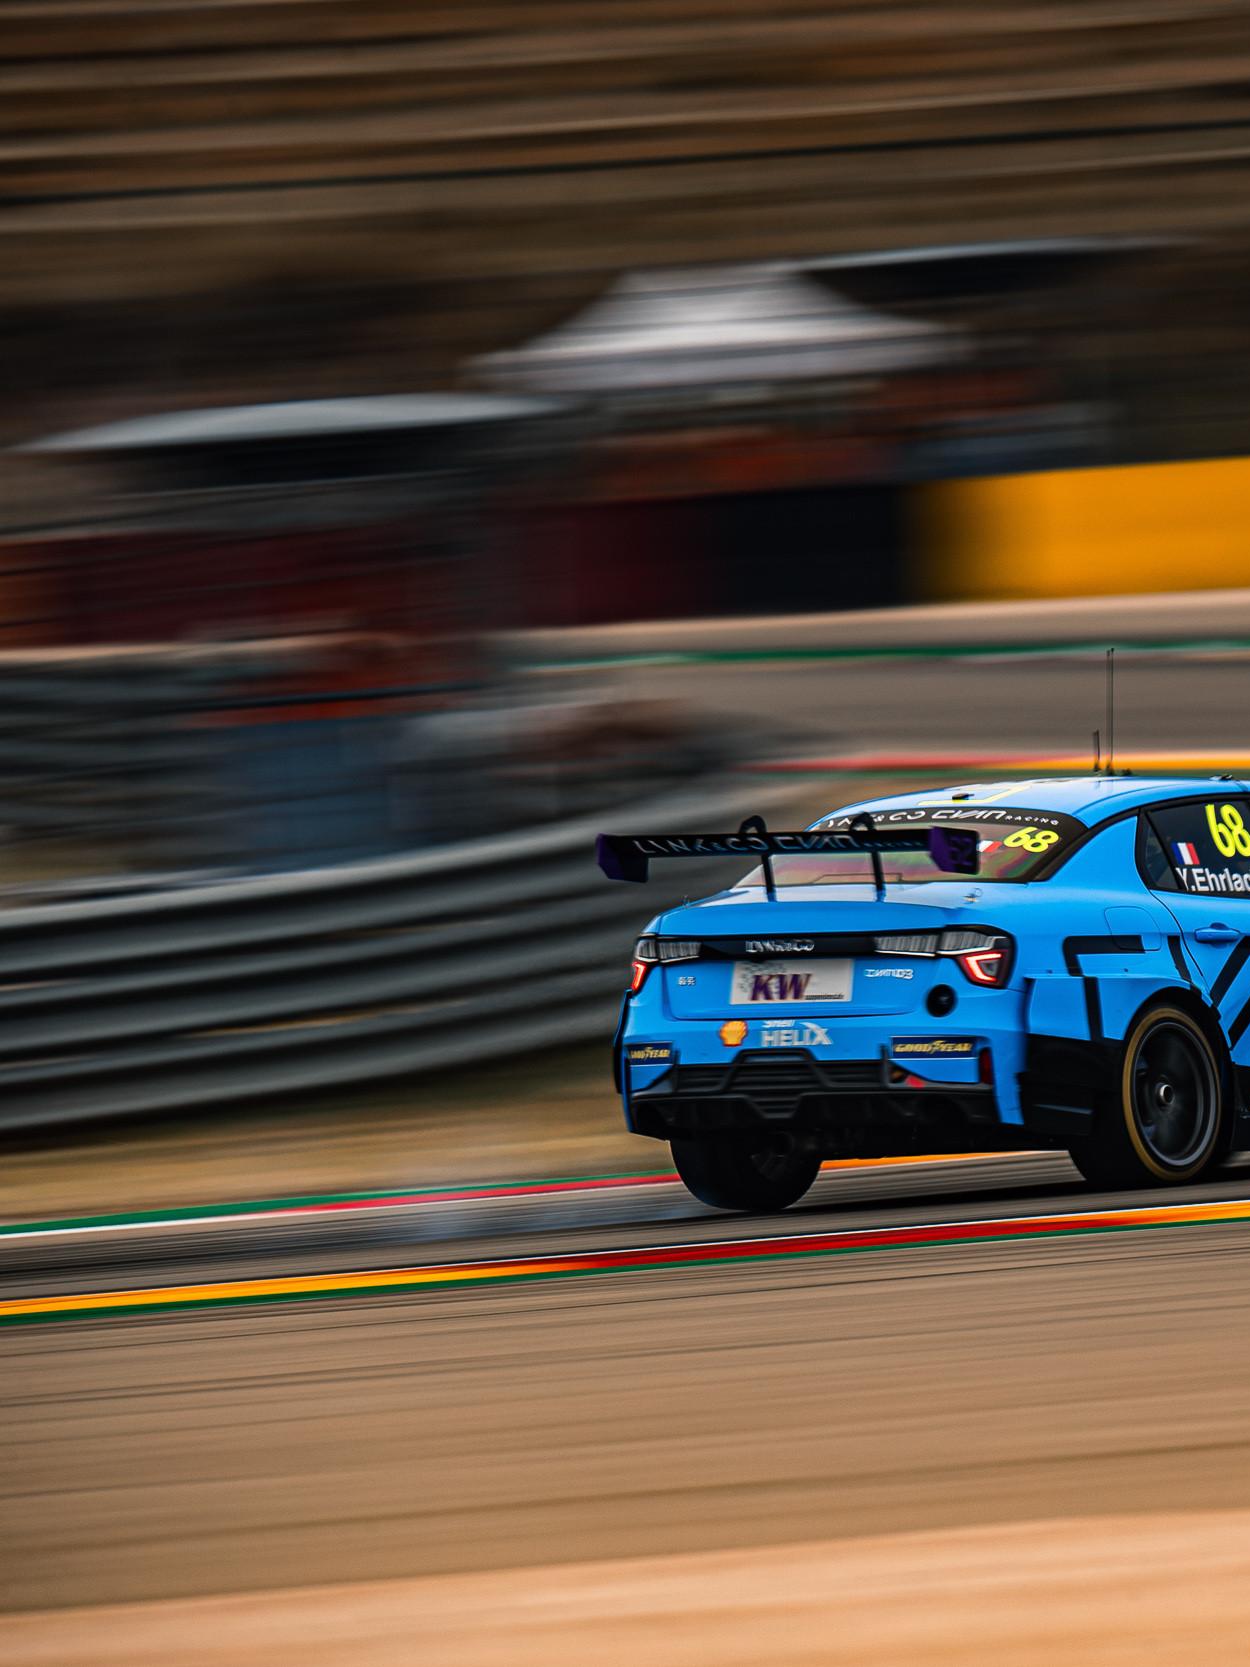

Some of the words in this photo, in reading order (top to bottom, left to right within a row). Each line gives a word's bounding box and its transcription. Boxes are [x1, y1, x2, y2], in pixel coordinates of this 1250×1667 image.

[1005, 815, 1059, 826] RACING
[1003, 826, 1060, 853] 68
[750, 973, 812, 1001] KW
[761, 1022, 833, 1047] HELIX
[895, 1040, 972, 1054] GOODYEAR
